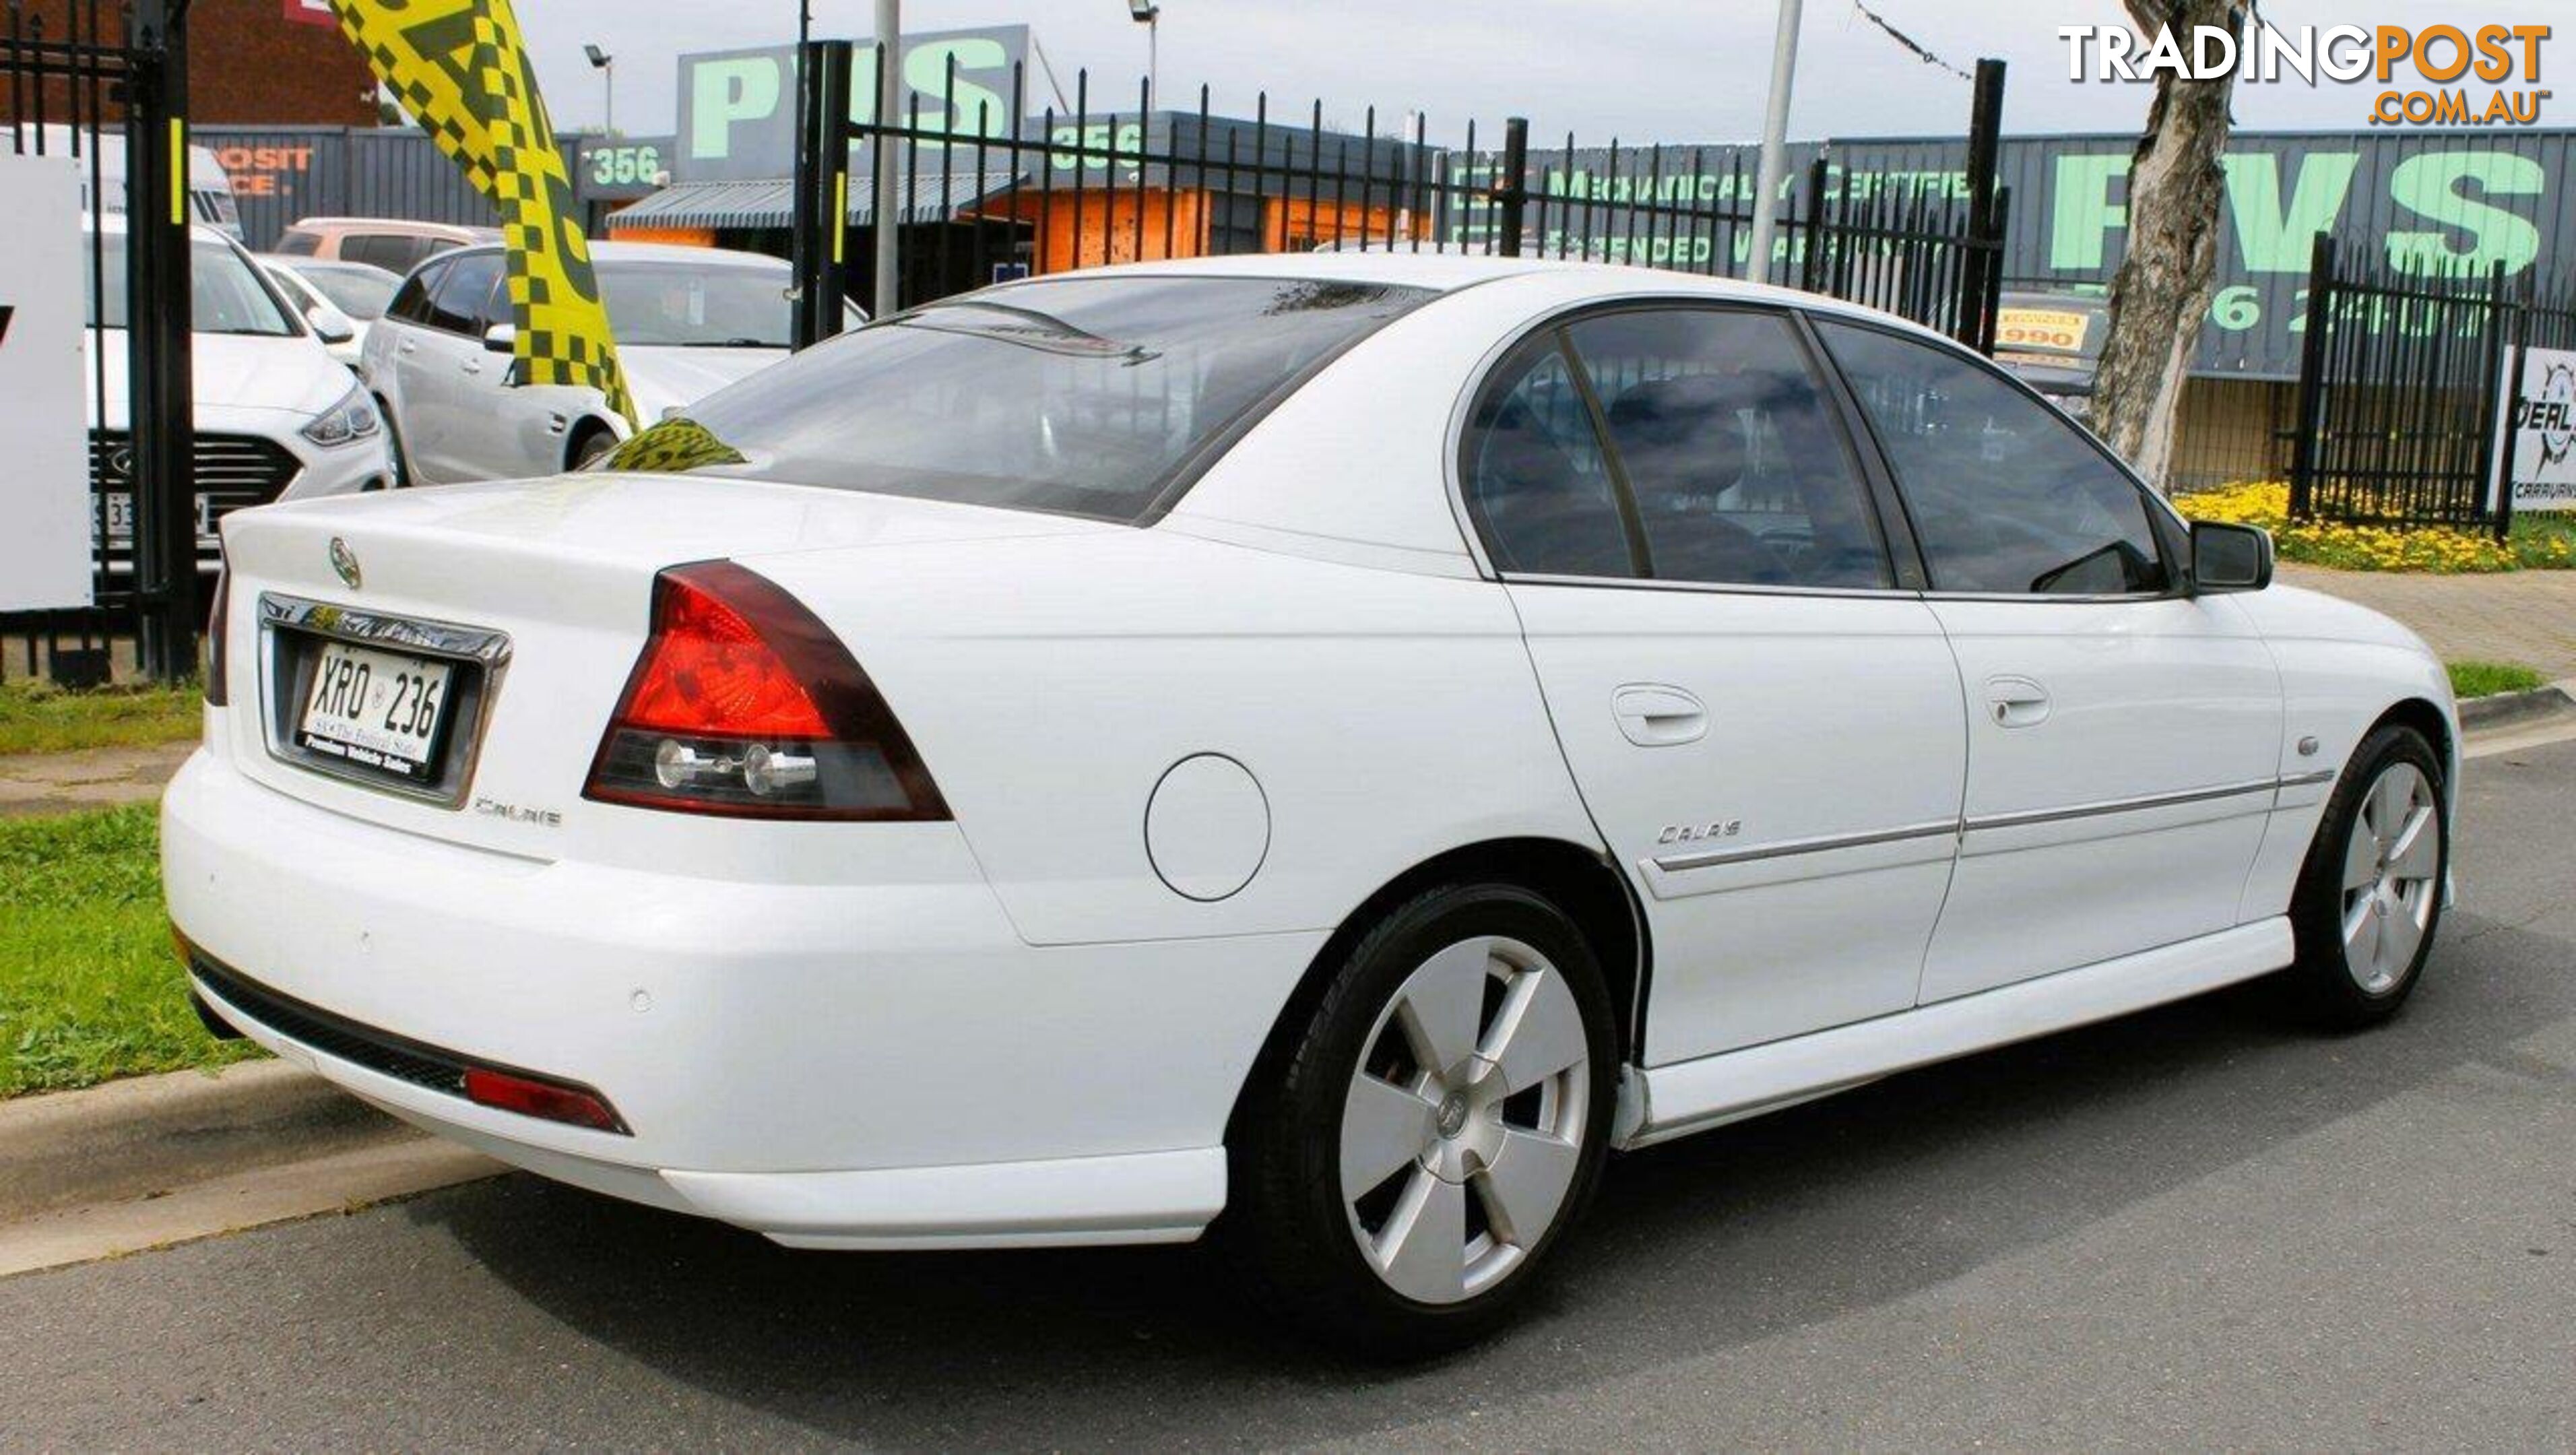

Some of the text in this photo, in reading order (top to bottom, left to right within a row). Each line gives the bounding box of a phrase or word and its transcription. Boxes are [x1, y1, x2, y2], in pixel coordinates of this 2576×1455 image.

[213, 144, 312, 170] OSIT
[593, 146, 659, 185] 356
[1052, 124, 1143, 170] 356
[1550, 165, 2000, 200] MECHANICALY CERTIFIE
[2051, 151, 2545, 278] PVS
[1997, 328, 2074, 347] 990
[313, 655, 439, 739] XRO 236
